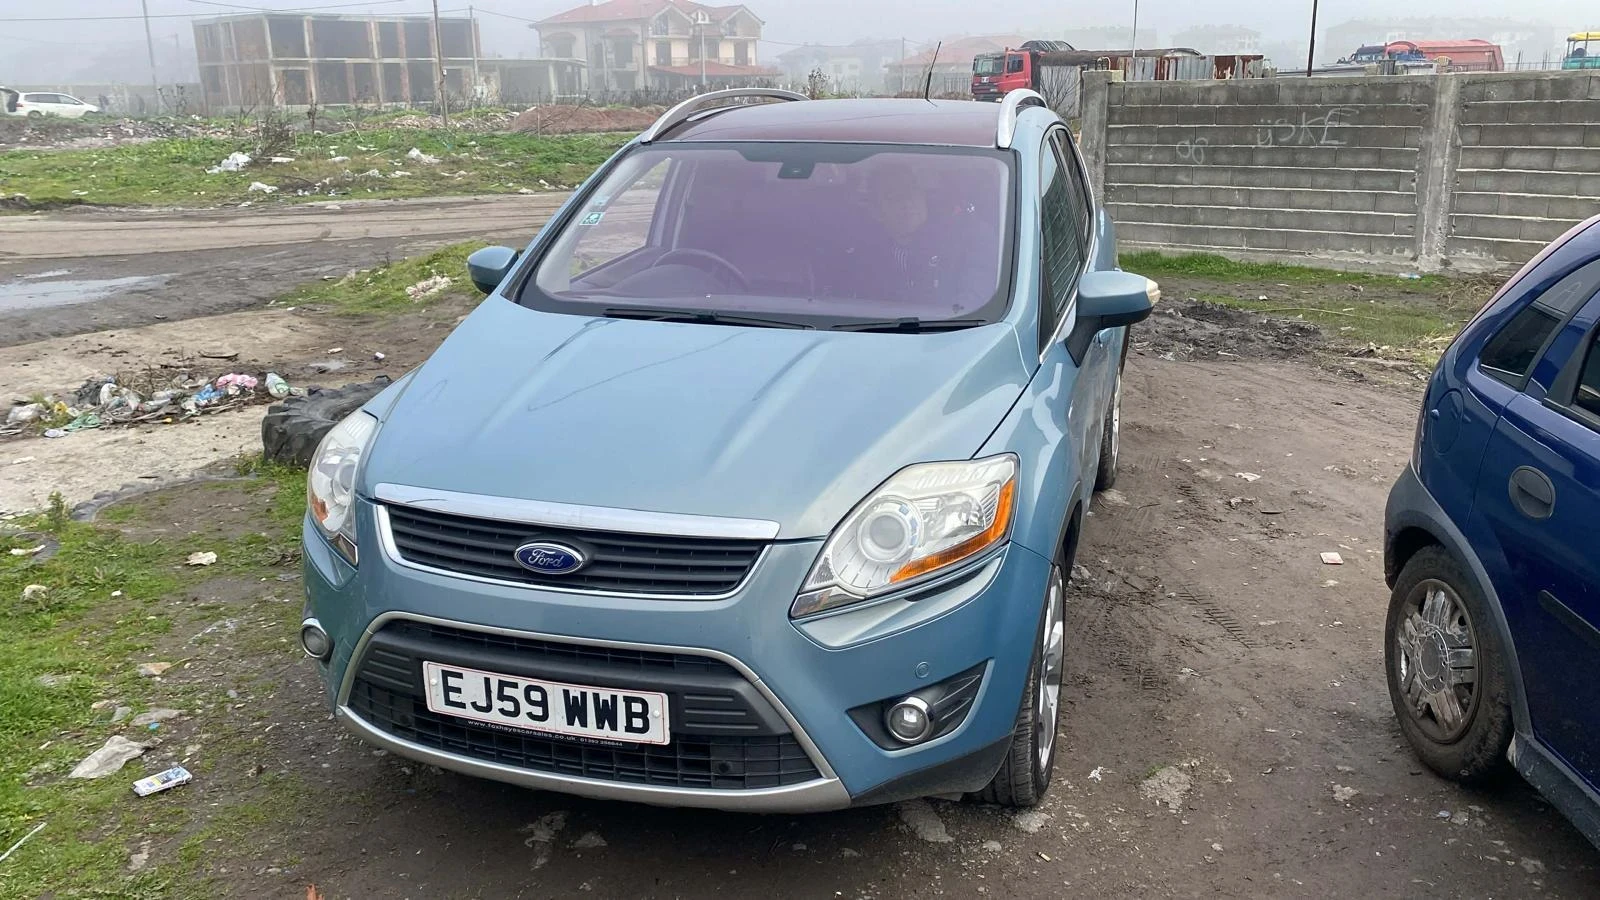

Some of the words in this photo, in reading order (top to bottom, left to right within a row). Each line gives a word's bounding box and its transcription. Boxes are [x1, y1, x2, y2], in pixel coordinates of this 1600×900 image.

[528, 548, 564, 567] Ford
[441, 669, 550, 722] EJ59
[562, 688, 650, 734] WWB
